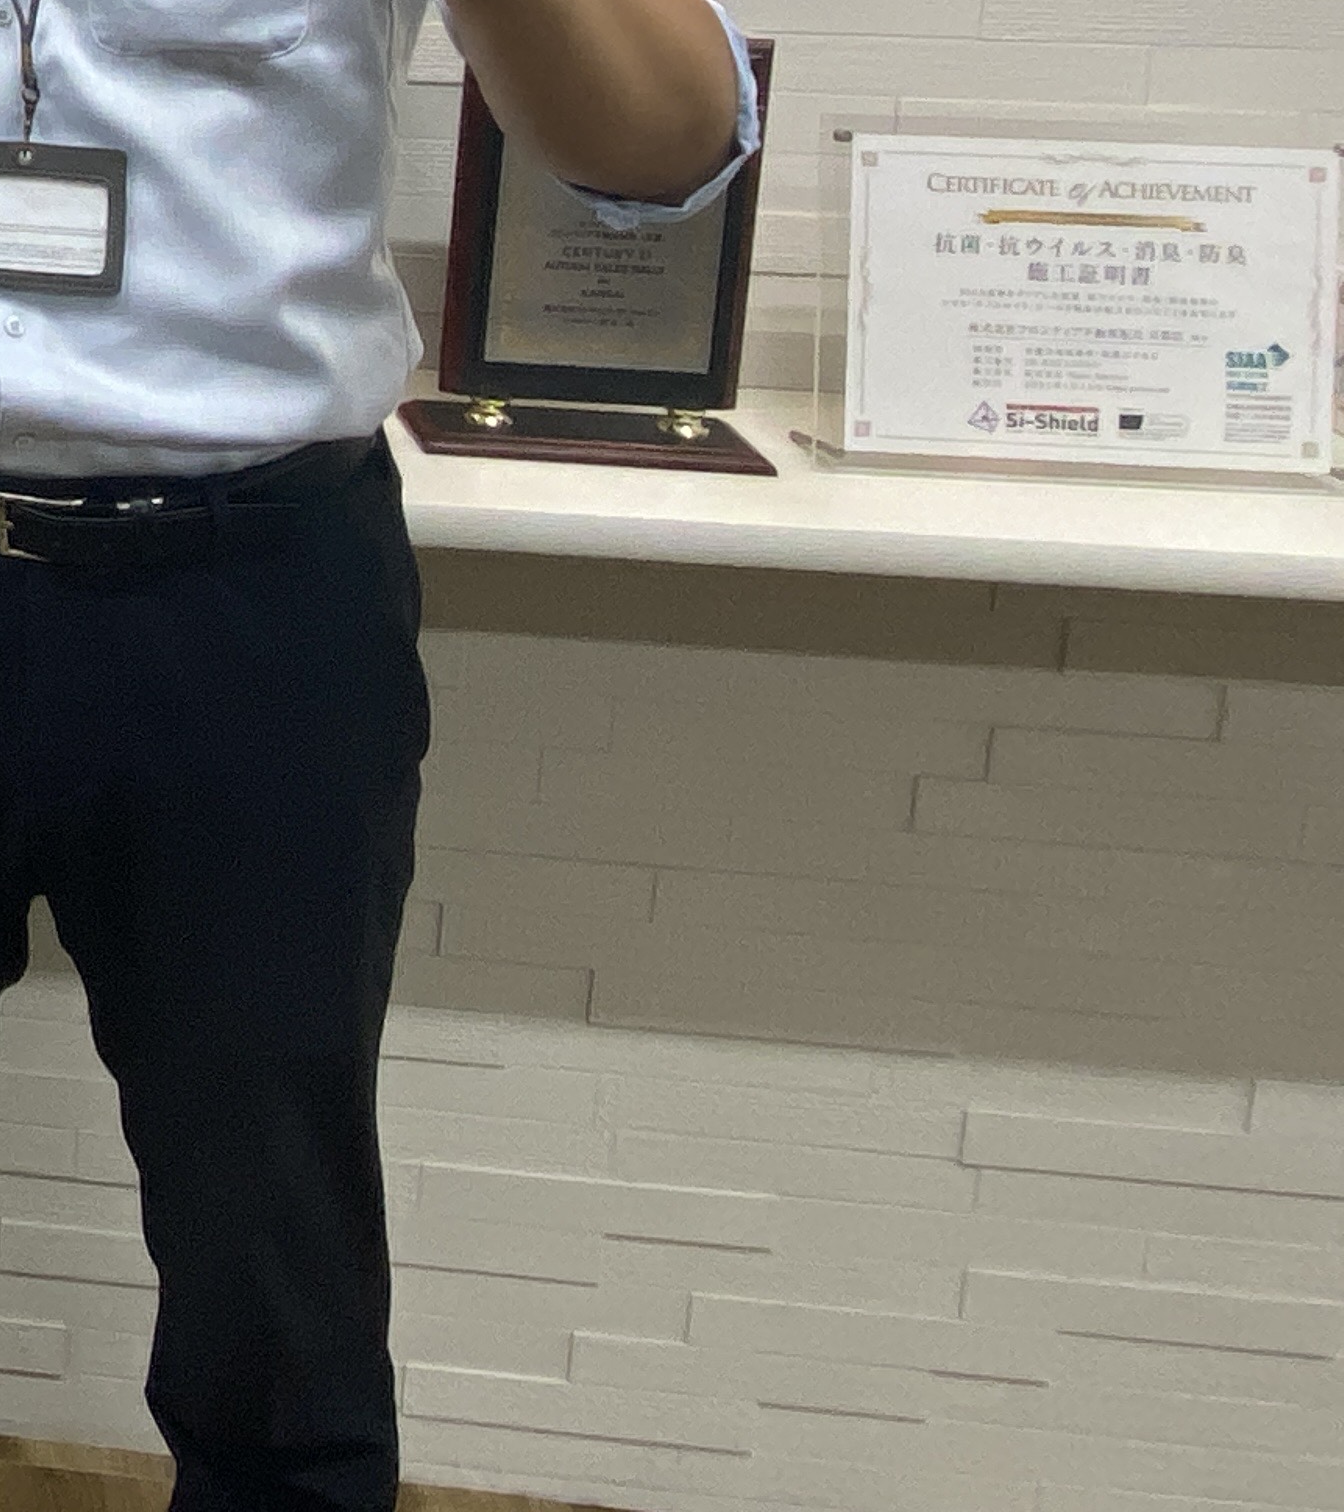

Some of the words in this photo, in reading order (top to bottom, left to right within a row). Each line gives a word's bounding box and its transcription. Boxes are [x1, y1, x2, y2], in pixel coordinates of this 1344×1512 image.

[926, 173, 1058, 198] CERTIFICATE
[1096, 180, 1259, 204] ACHIEVEMENT
[1028, 262, 1151, 286] 施工証明書
[1006, 412, 1100, 434] Si-Shield
